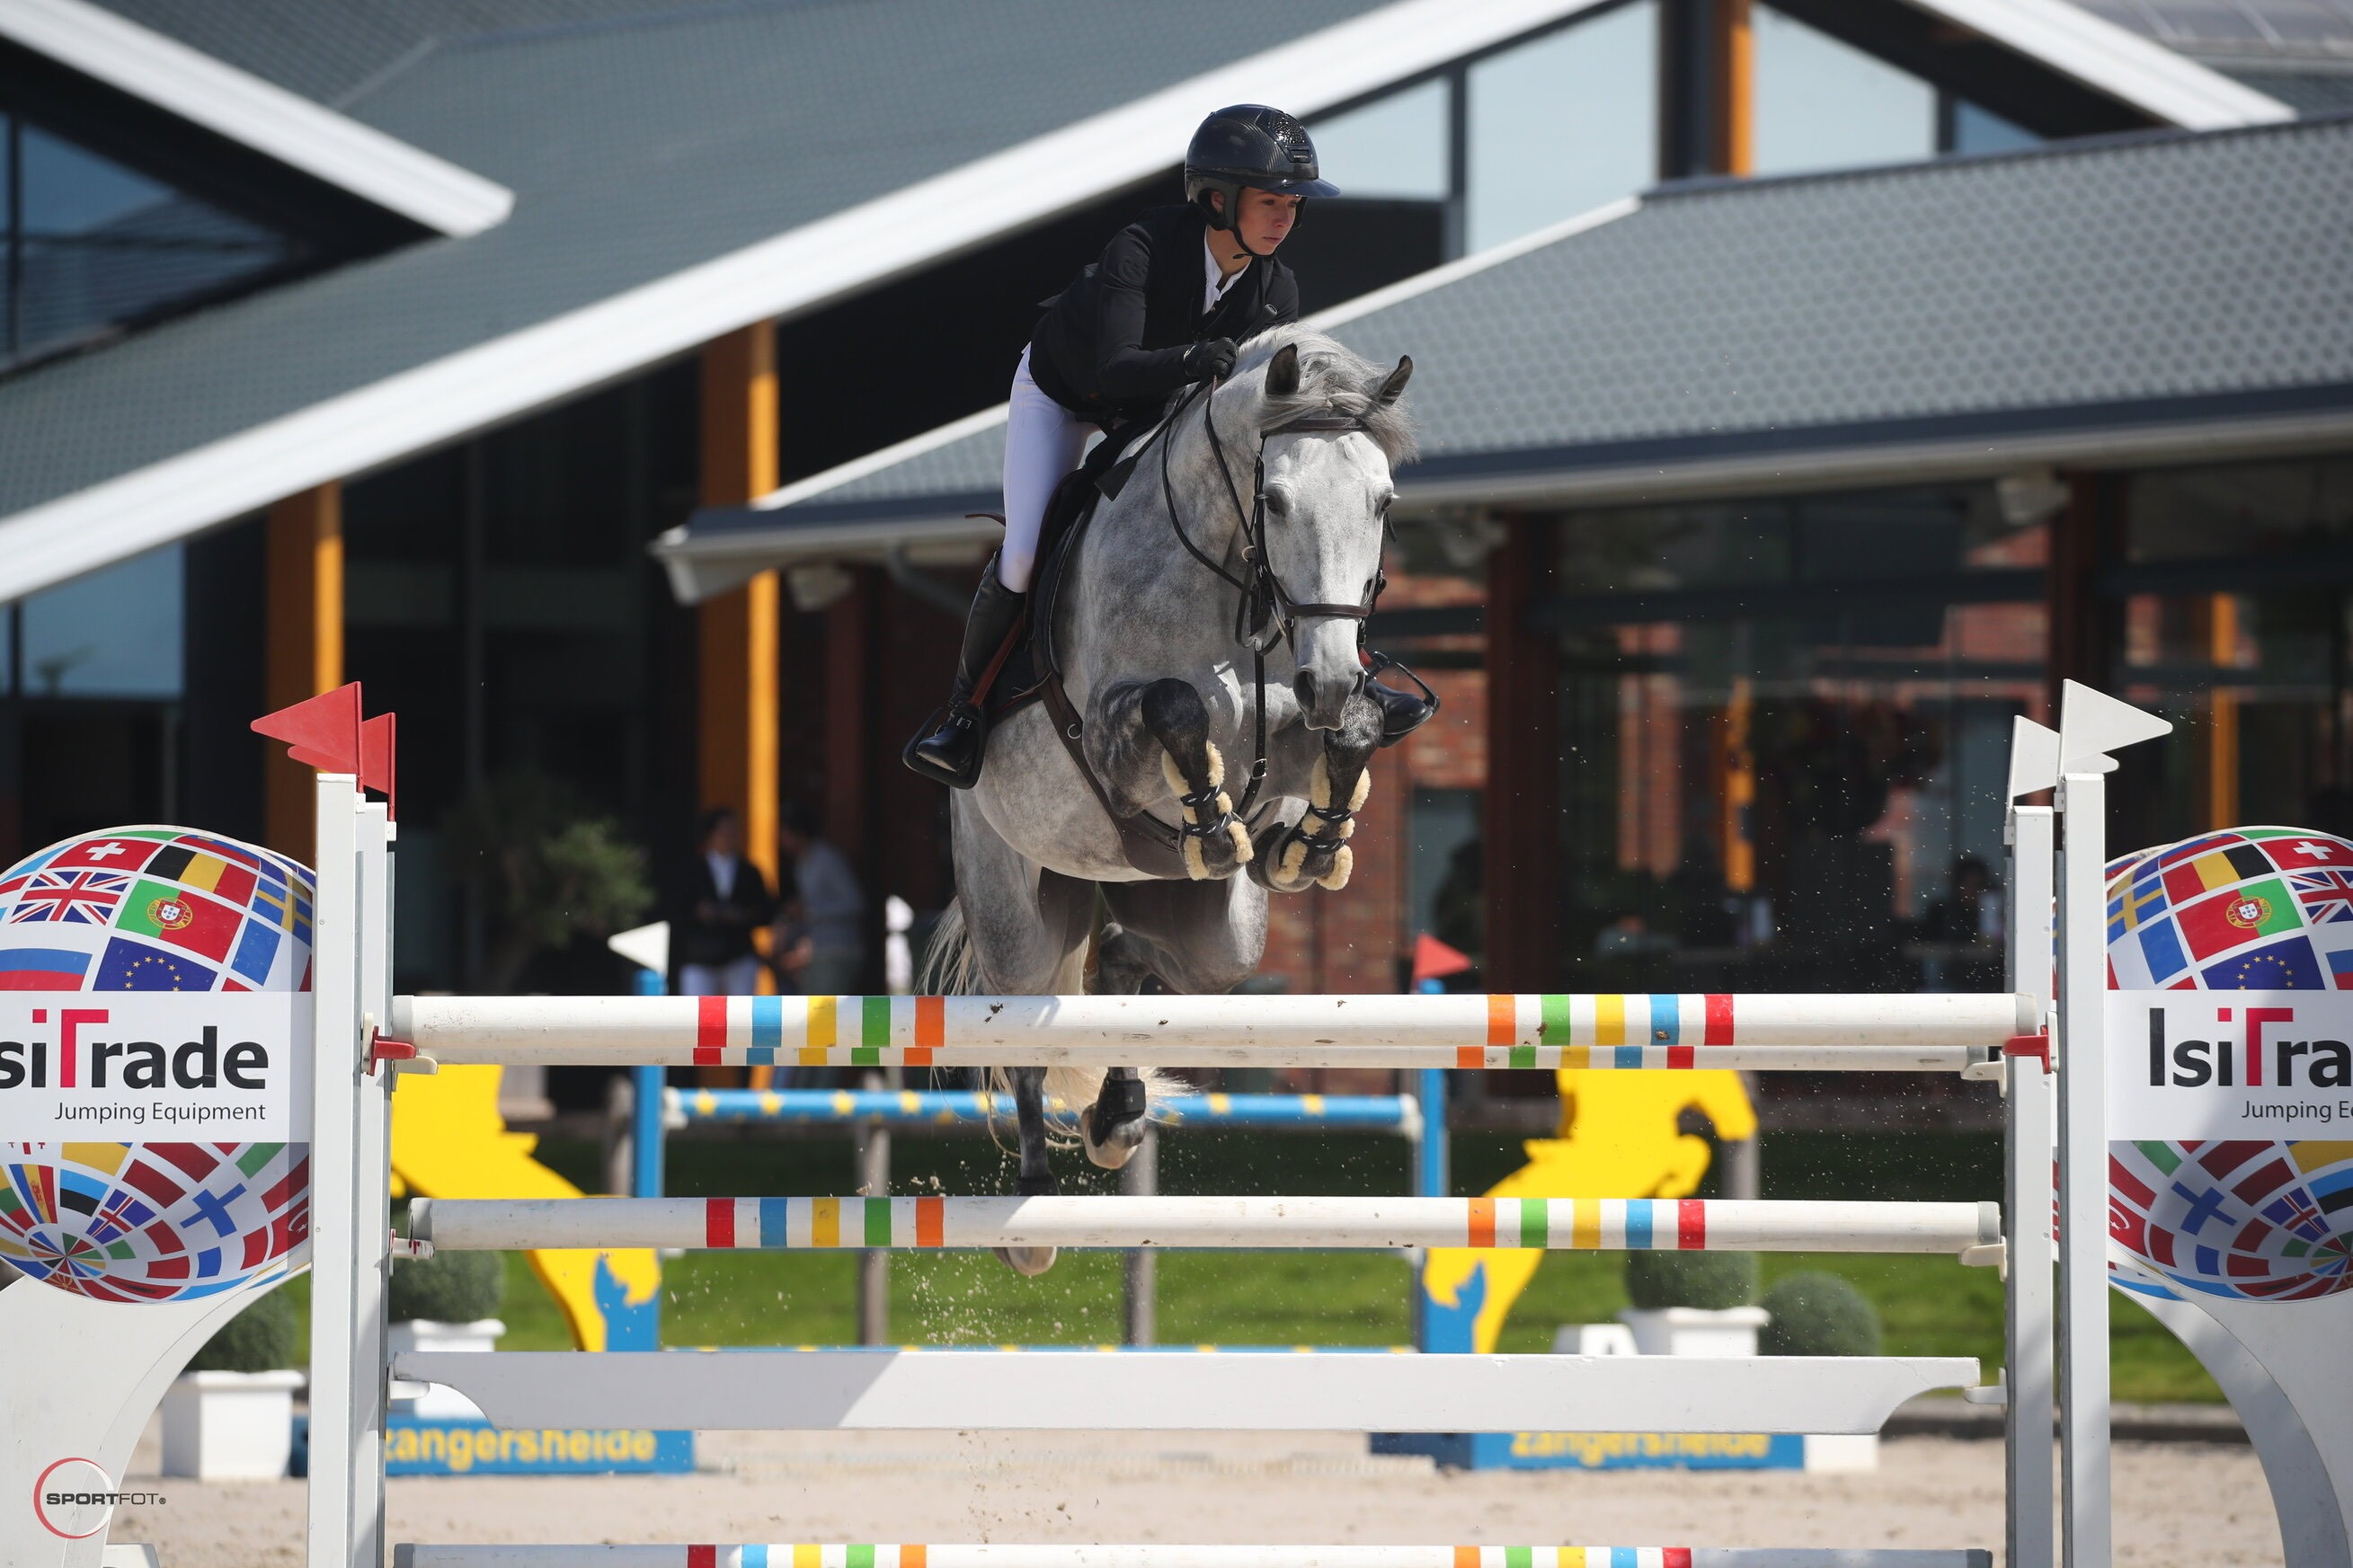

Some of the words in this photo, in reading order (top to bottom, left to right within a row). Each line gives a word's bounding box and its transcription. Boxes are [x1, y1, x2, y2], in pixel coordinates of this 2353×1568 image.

[54, 1102, 146, 1124] Jumping
[152, 1102, 266, 1124] Equipment
[2242, 1100, 2331, 1123] Jumping
[2339, 1100, 2353, 1118] E
